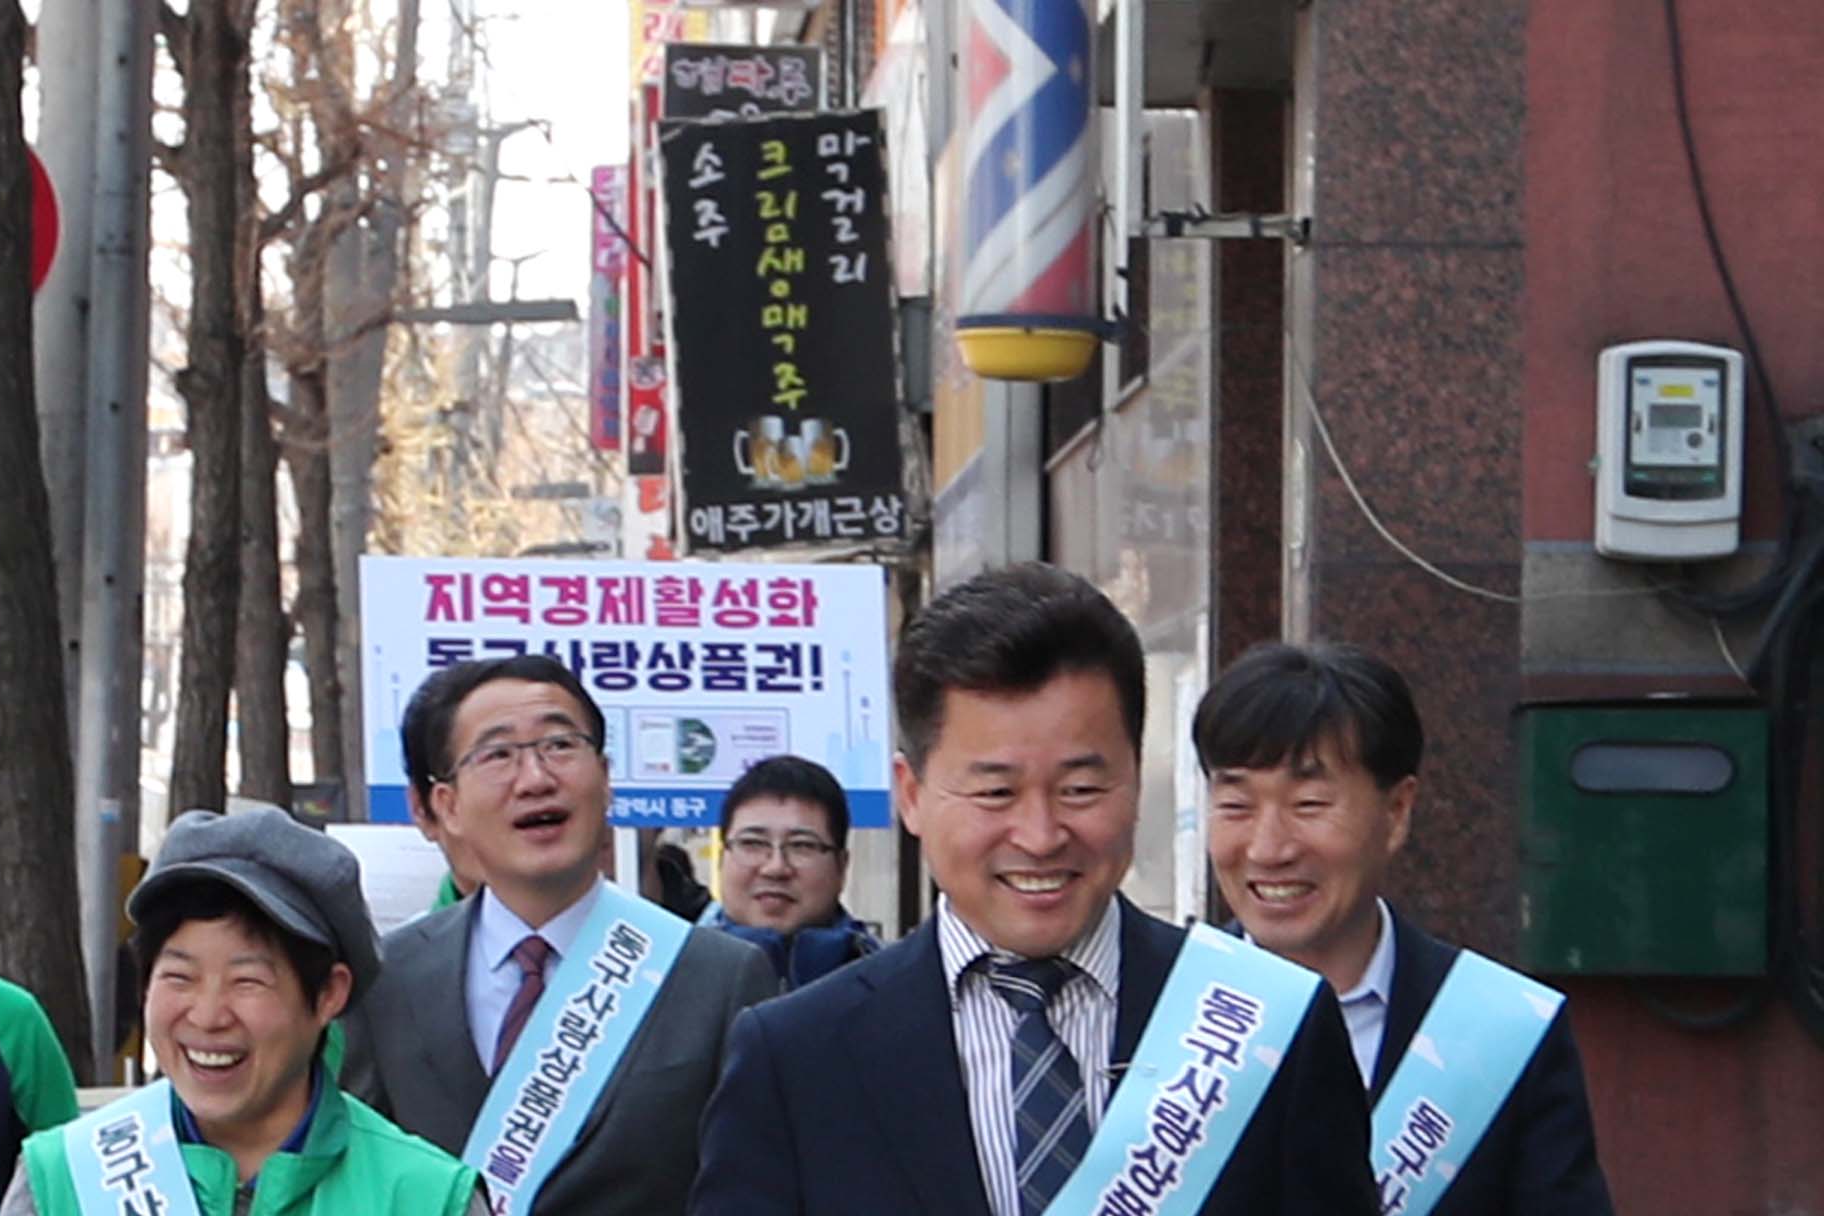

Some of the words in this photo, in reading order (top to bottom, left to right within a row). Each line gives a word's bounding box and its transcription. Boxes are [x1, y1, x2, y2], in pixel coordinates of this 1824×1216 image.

[688, 140, 730, 248] 소주
[817, 131, 870, 285] 막걸리
[756, 140, 808, 409] 크림생맥주
[424, 573, 818, 628] 지역경제활성화
[671, 797, 707, 819] 동구
[488, 924, 649, 1186] 동구사랑상품권을
